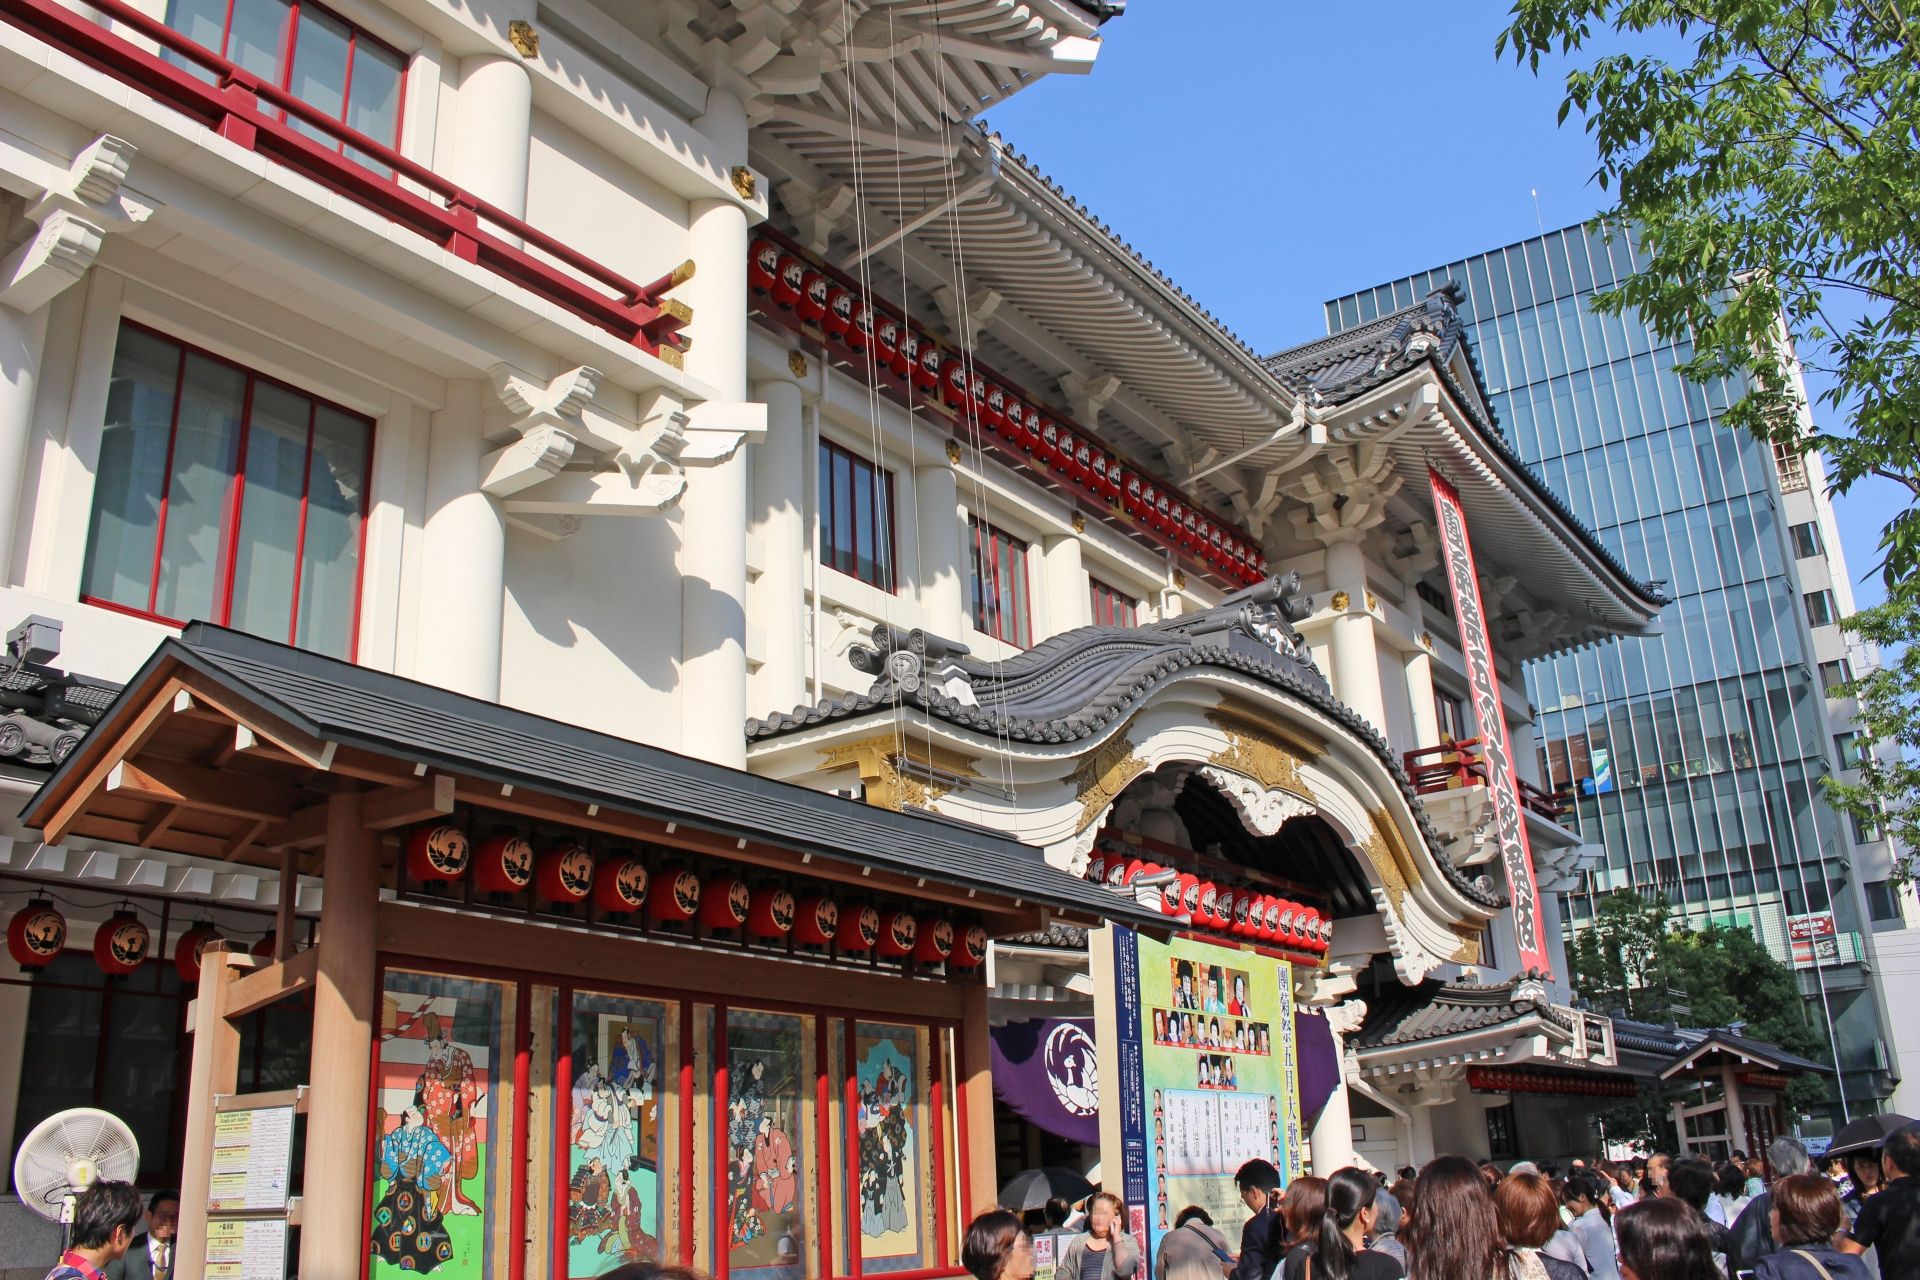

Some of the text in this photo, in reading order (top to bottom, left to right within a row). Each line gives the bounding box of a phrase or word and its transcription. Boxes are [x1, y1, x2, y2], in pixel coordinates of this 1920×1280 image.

[1278, 966, 1300, 1181] 團菊祭五月大歌舞
